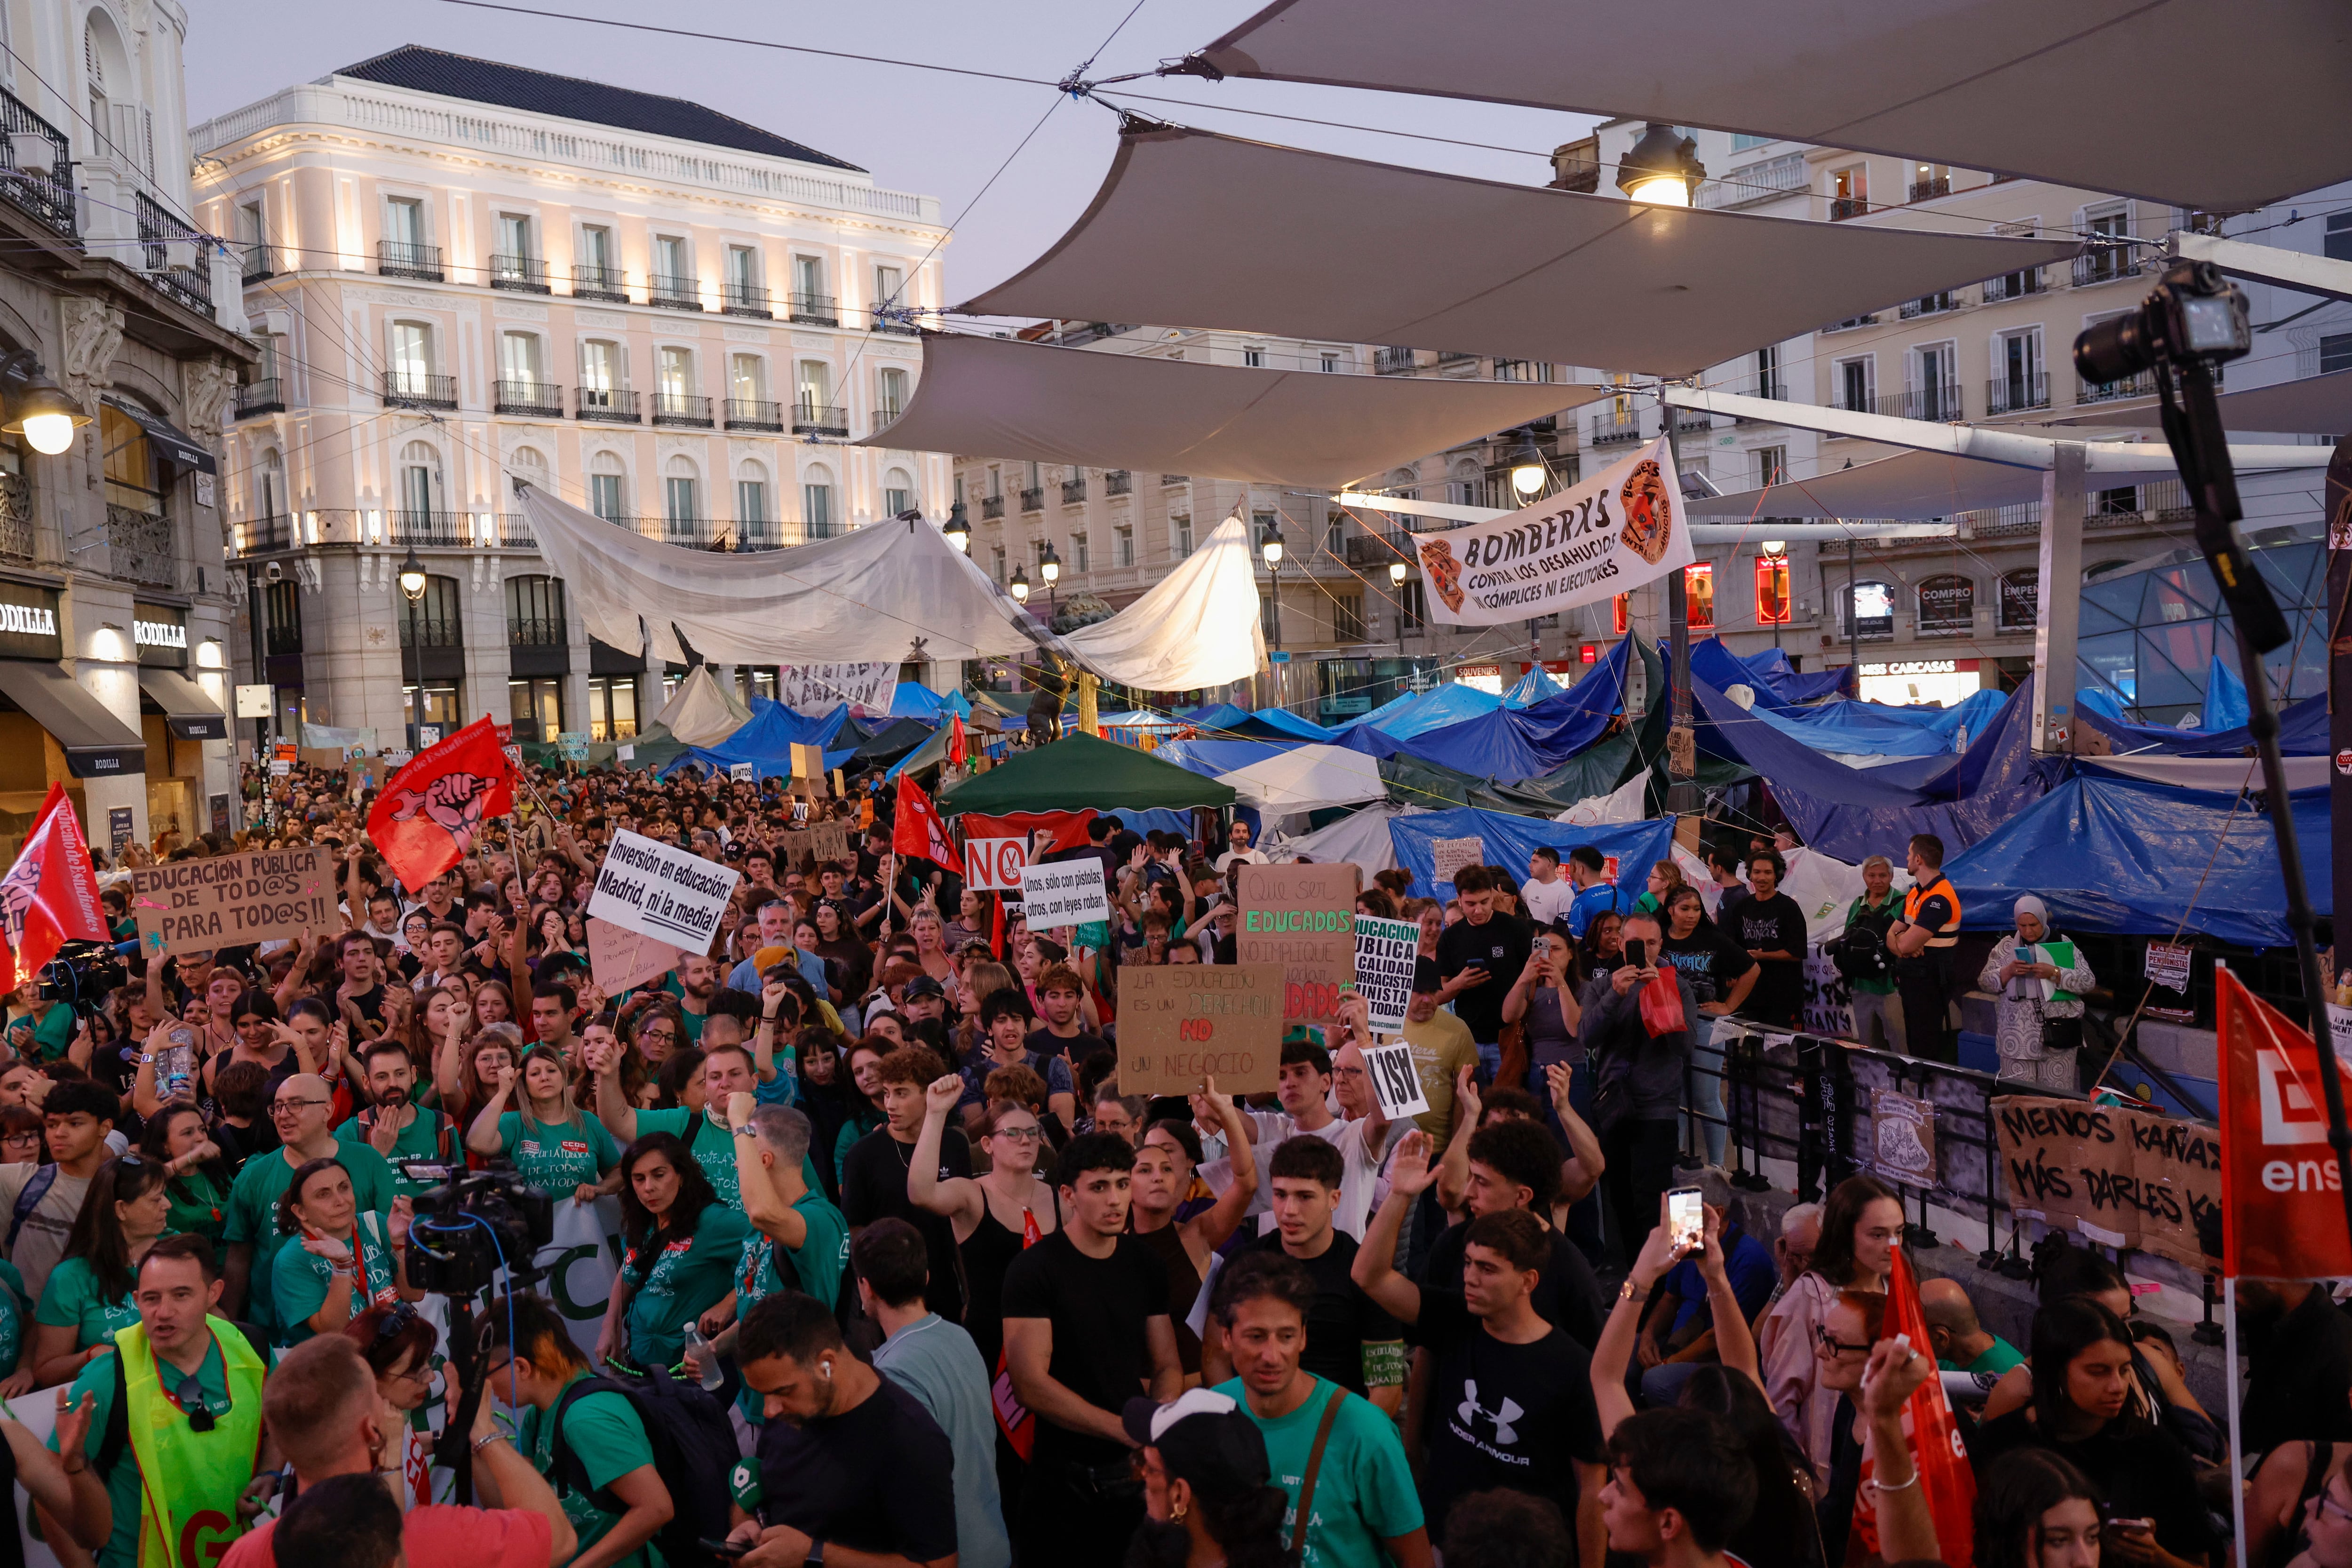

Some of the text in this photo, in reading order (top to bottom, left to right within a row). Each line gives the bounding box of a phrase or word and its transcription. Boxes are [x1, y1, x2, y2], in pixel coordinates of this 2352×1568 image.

[1465, 489, 1611, 567] BOMBERXS
[1621, 532, 1647, 557] ONTRA
[1469, 532, 1616, 589] CONTRA LOS DESAHUCIOS
[1485, 587, 1542, 609] CÓMPLICES
[1545, 583, 1556, 596] NI
[1560, 558, 1619, 594] EJECUTORES
[1922, 588, 1971, 599] COMPRO
[0, 604, 56, 636] ODILLA
[134, 620, 187, 648] RODILLA
[1459, 666, 1497, 676] SOUVENIRS
[1859, 660, 1955, 675] MISS CARCASAS
[95, 758, 119, 769] RODILLA
[732, 770, 752, 779] JUNTOS
[610, 836, 731, 901] Inversión en educación:
[967, 840, 1026, 888] NO
[171, 873, 301, 908] DE TOD@S
[1024, 868, 1103, 893] Unos, sólo con pistolas;
[1248, 873, 1337, 901] Que ser
[70, 864, 100, 933] Estudiantes
[597, 869, 719, 932] Madrid, ni la media!
[1027, 901, 1049, 918] otros,
[1049, 901, 1063, 914] con
[1064, 898, 1082, 916] leyes
[1083, 894, 1105, 909] roban.
[162, 897, 326, 941] PARA TOD@S!!
[1246, 910, 1351, 933] EDUCADOS
[1240, 941, 1335, 962] NO IMPLIQUE
[1355, 932, 1414, 961] ÚBLICA
[1358, 955, 1414, 976] CALIDAD
[1134, 971, 1154, 988] LA
[1134, 999, 1151, 1011] ES
[1157, 998, 1175, 1011] UN
[1370, 1001, 1406, 1018] TODAS
[1180, 1019, 1213, 1042] NO
[1367, 1020, 1402, 1029] VOLUCIONARIA
[1131, 1051, 1254, 1077] UN NEGOCIO
[2001, 1107, 2115, 1146] MENOS
[2011, 1147, 2072, 1201] MÁS
[2081, 1168, 2182, 1223] DARLES
[1476, 1440, 1530, 1466] ARMOUR
